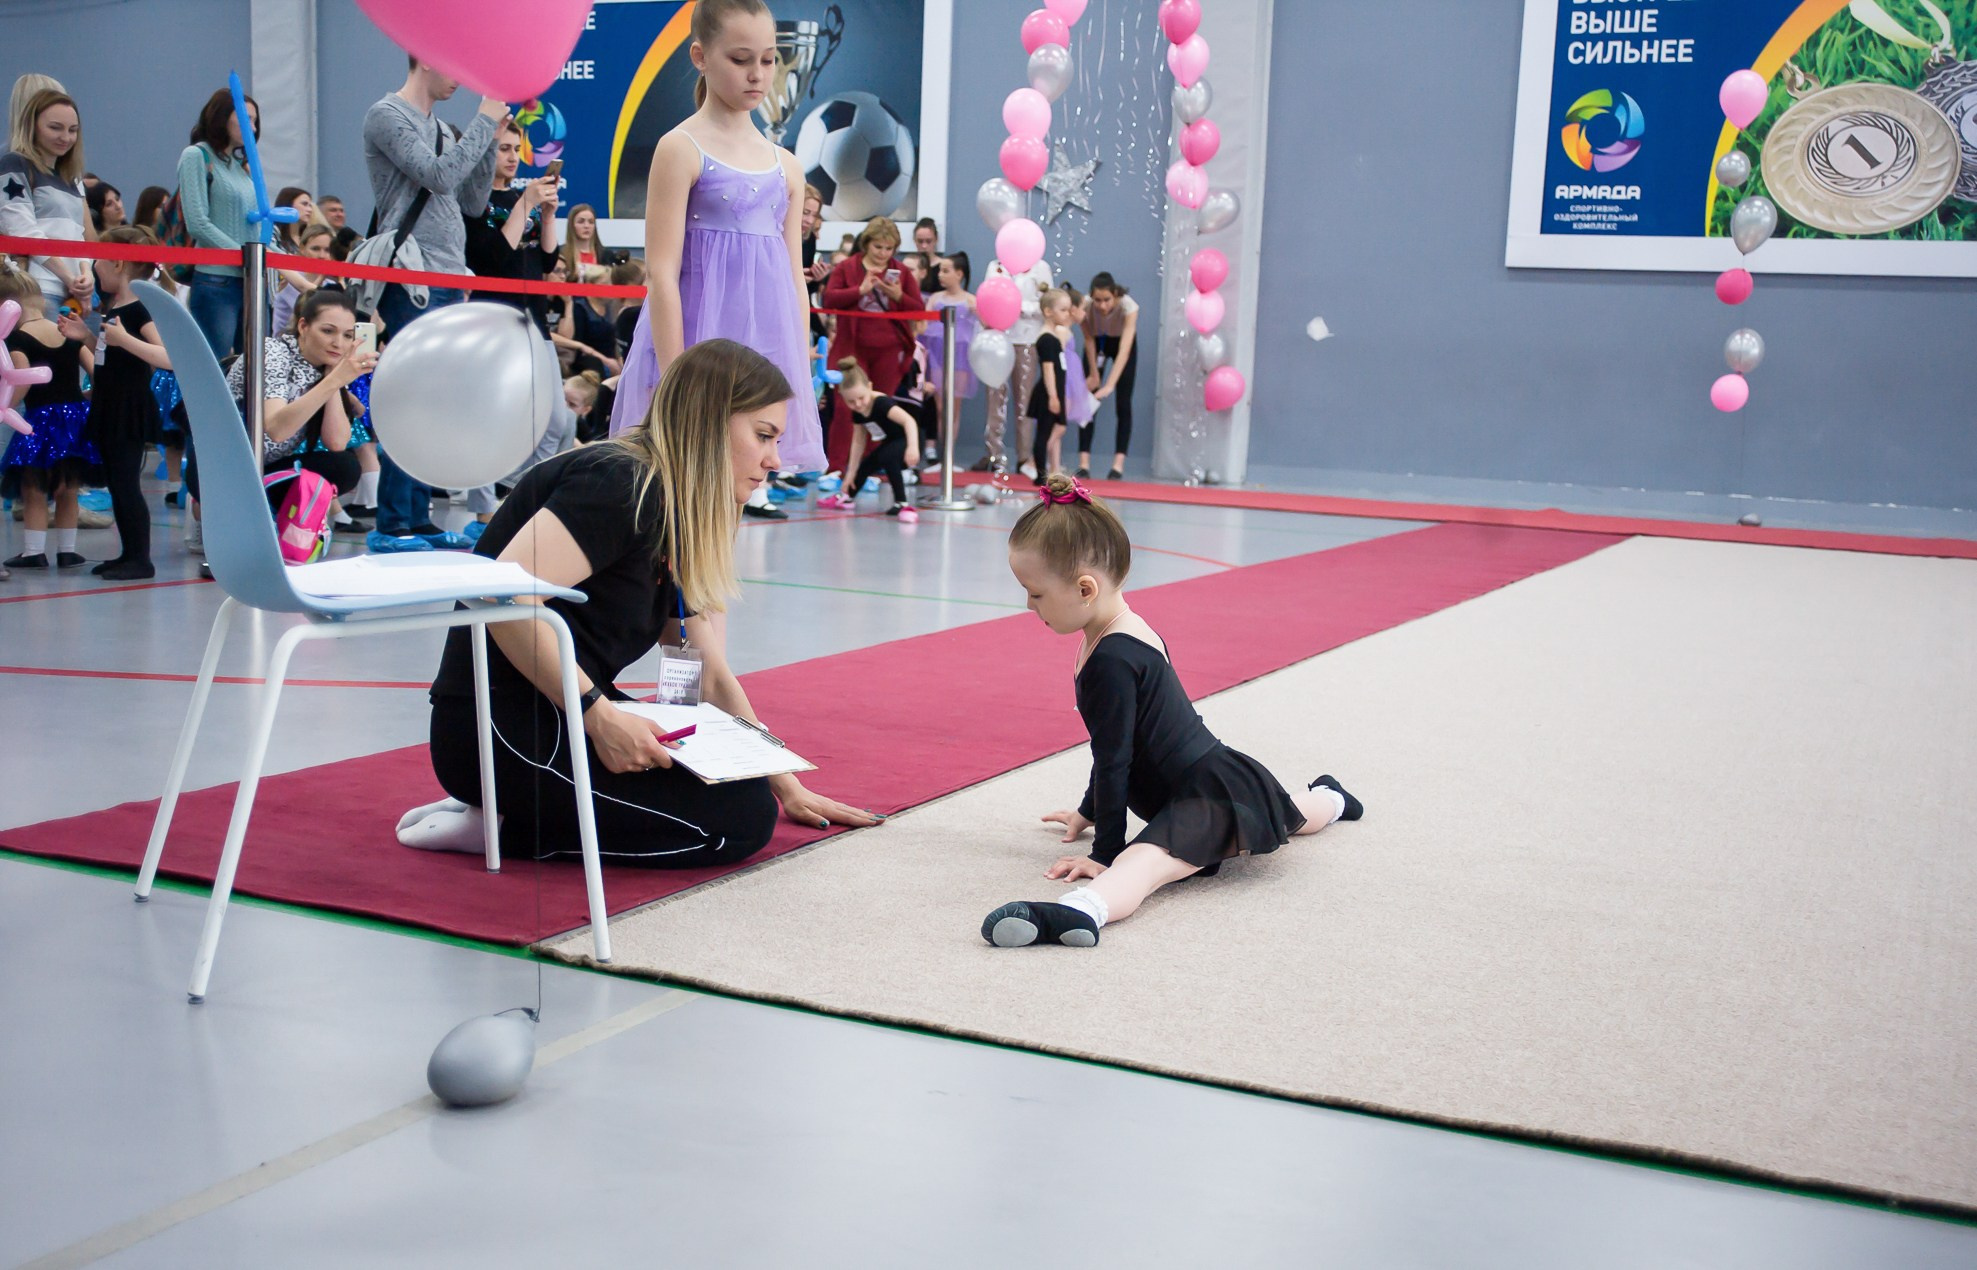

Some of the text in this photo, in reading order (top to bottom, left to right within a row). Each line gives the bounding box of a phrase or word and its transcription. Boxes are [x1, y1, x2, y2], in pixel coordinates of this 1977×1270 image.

[1570, 9, 1659, 34] ВЫШЕ
[1567, 39, 1695, 65] СИЛЬНЕЕ
[1841, 133, 1883, 170] 1
[1555, 184, 1641, 200] АРМАДА
